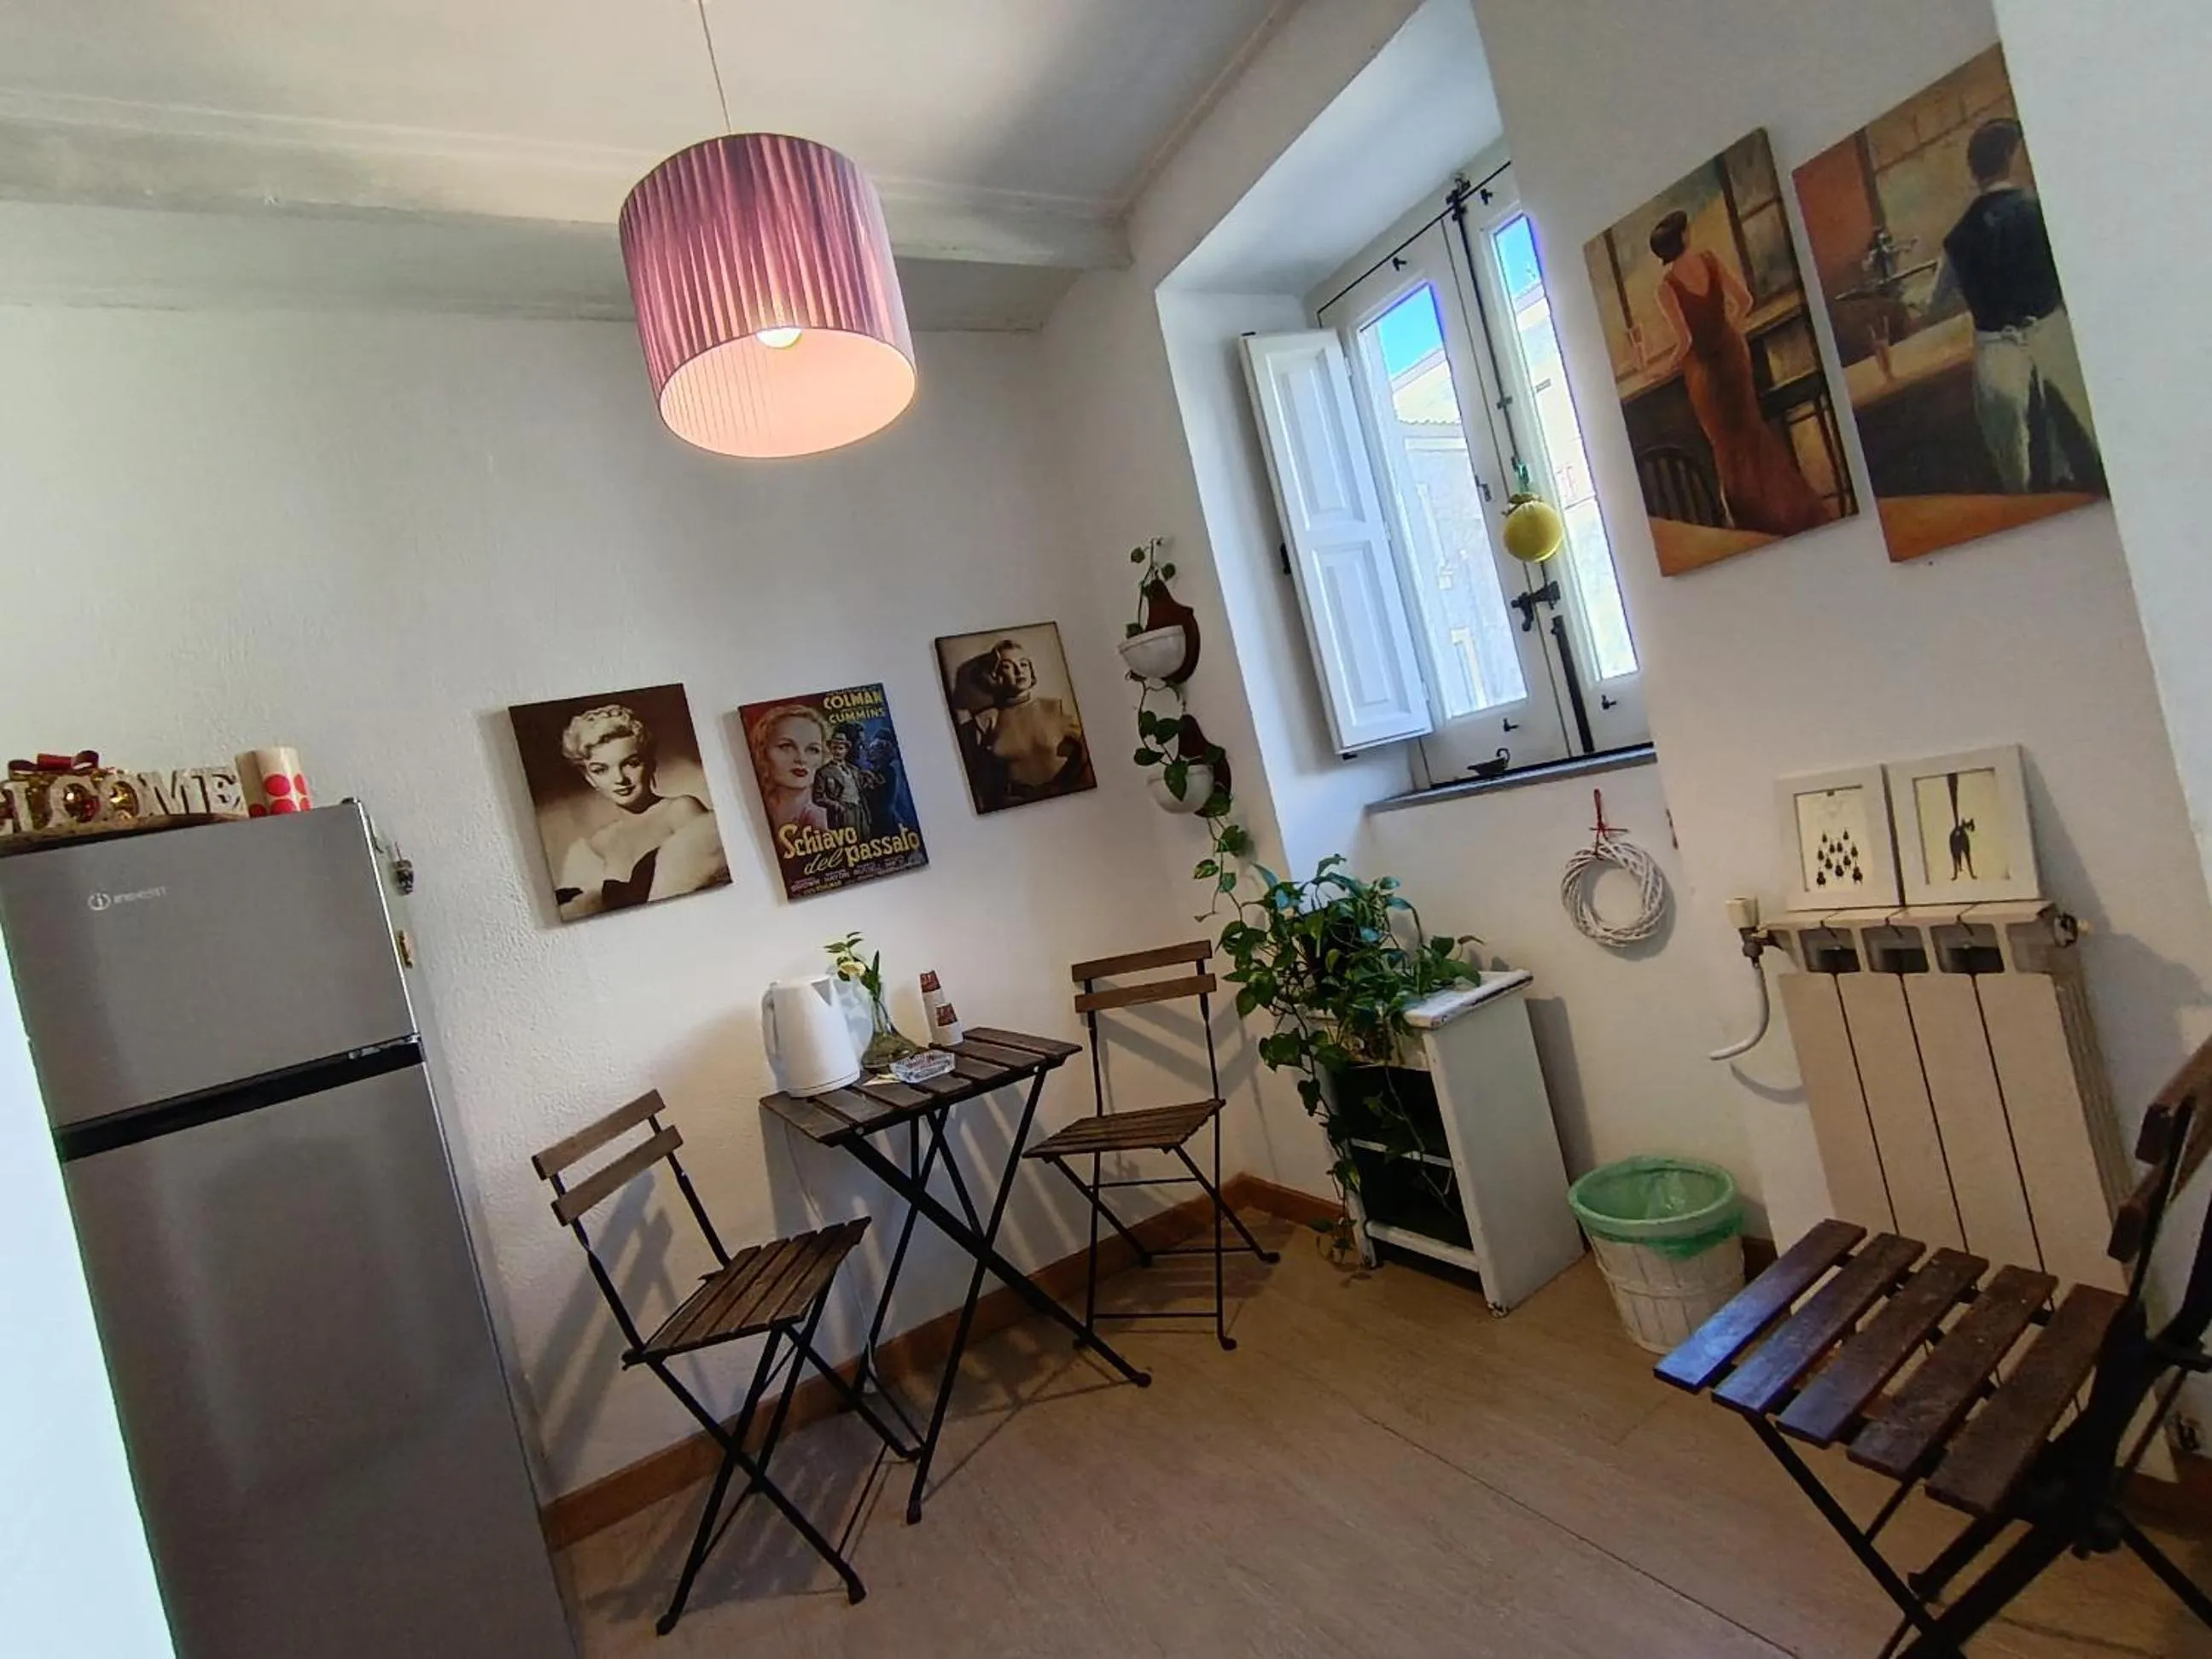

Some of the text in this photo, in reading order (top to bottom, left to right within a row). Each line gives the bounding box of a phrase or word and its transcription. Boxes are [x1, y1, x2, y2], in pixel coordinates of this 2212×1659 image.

[824, 690, 883, 710] COLMAN
[829, 707, 885, 724] CUMMINS
[778, 824, 858, 859] Schiavo
[804, 848, 843, 876] del
[845, 824, 920, 867] passato
